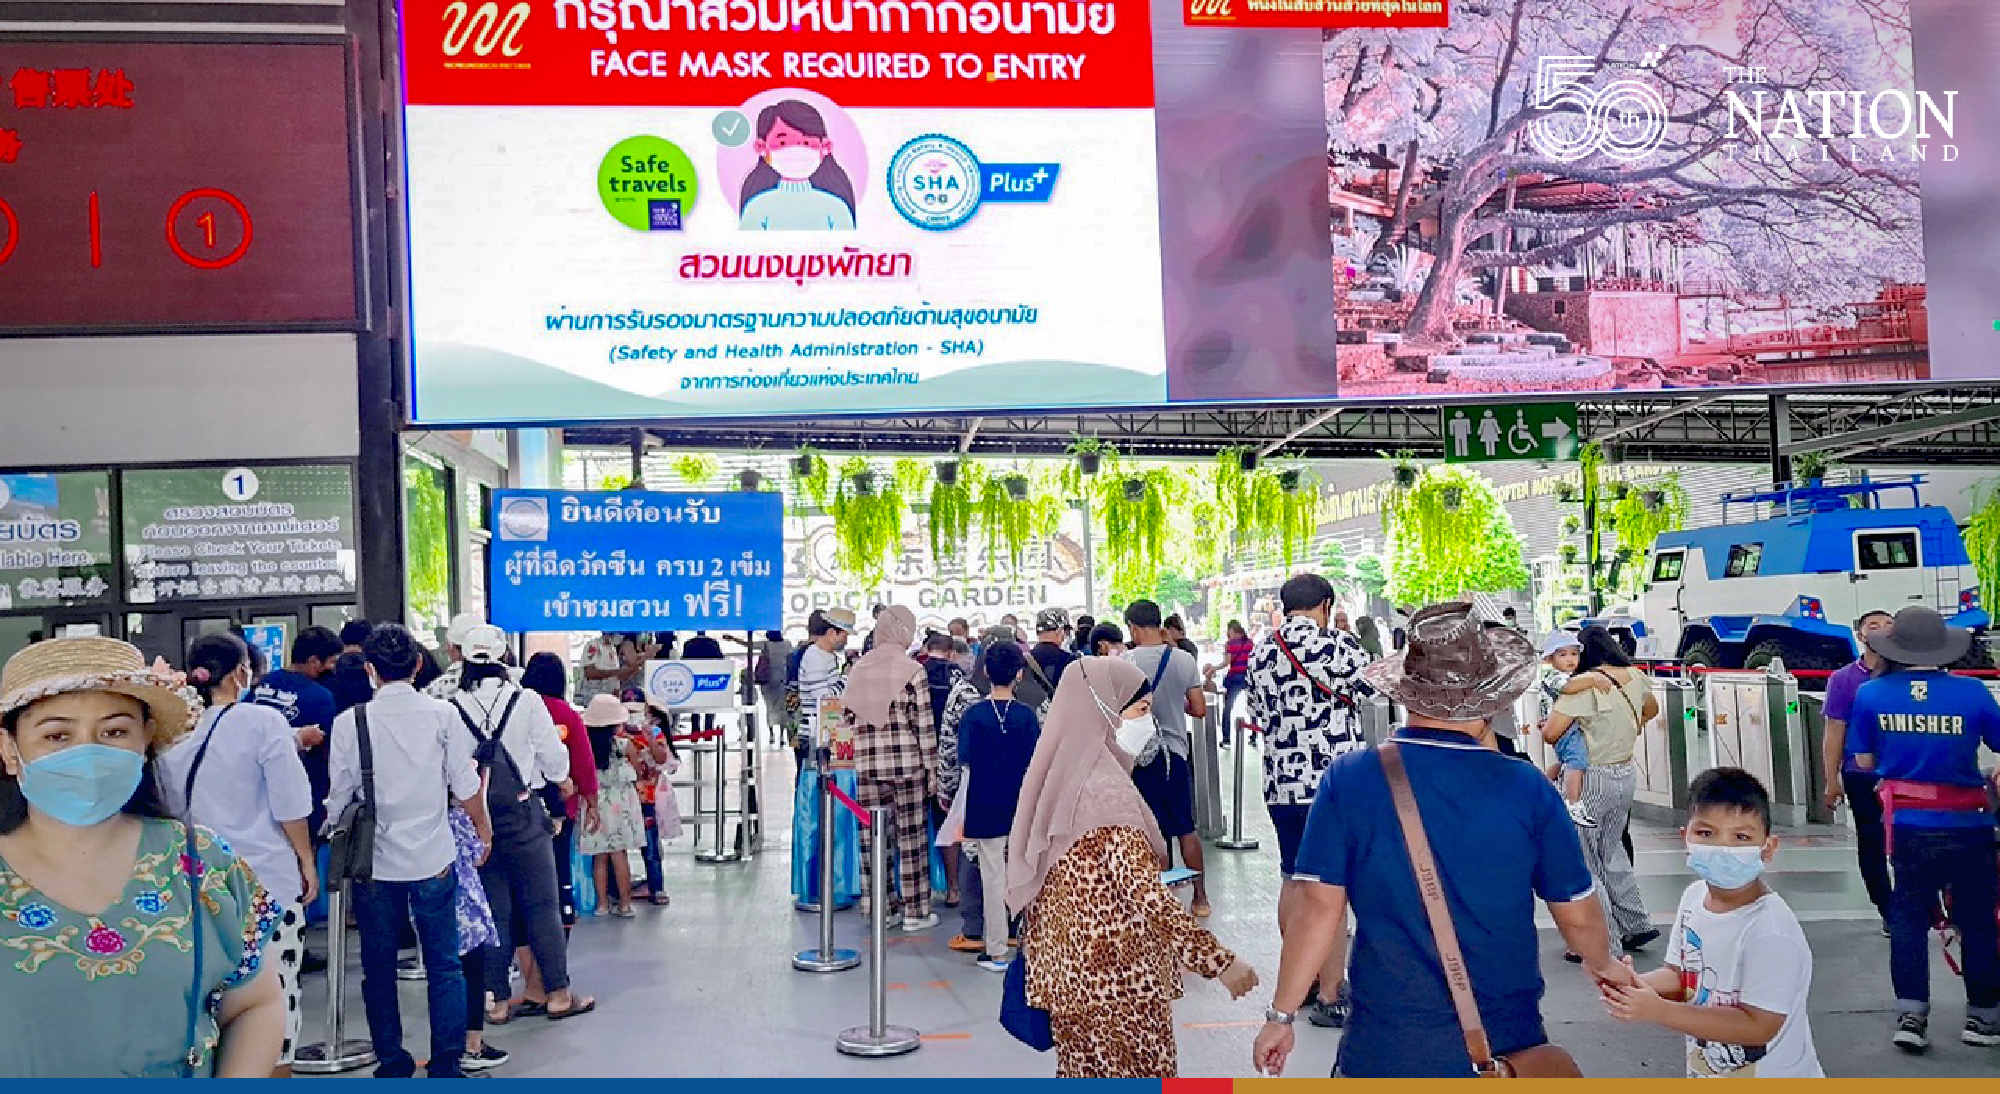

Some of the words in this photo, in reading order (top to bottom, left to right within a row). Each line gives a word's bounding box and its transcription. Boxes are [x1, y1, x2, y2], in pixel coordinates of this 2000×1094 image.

[591, 50, 667, 77] FACE
[680, 51, 772, 77] MASK
[784, 51, 930, 78] REQUIRED
[939, 52, 983, 79] TO
[994, 53, 1086, 80] ENTRY
[621, 153, 669, 173] Safe
[609, 173, 687, 193] travels
[914, 174, 960, 190] SHA
[679, 246, 912, 287] สวนนงนุชพัทยา
[609, 344, 678, 364] (Safety
[684, 344, 718, 360] and
[725, 343, 783, 359] Health
[790, 341, 918, 357] Administration
[940, 339, 984, 357] SHA)
[232, 475, 244, 496] 1
[561, 496, 721, 524] ยินดีต้อนรับ
[47, 549, 88, 567] Here
[194, 542, 245, 556] Check
[247, 541, 284, 555] Your
[251, 560, 278, 573] the
[280, 558, 338, 573] counte
[505, 546, 645, 586] ผู้ที่ฉีดวัคซีน
[656, 558, 704, 577] ครบ
[711, 558, 724, 577] 2
[730, 551, 770, 577] เข็ม
[544, 591, 671, 618] เข้าชมสวน
[684, 579, 743, 617] ฟรี!
[918, 585, 1047, 609] GARDEN
[1878, 713, 1963, 735] FINISHER
